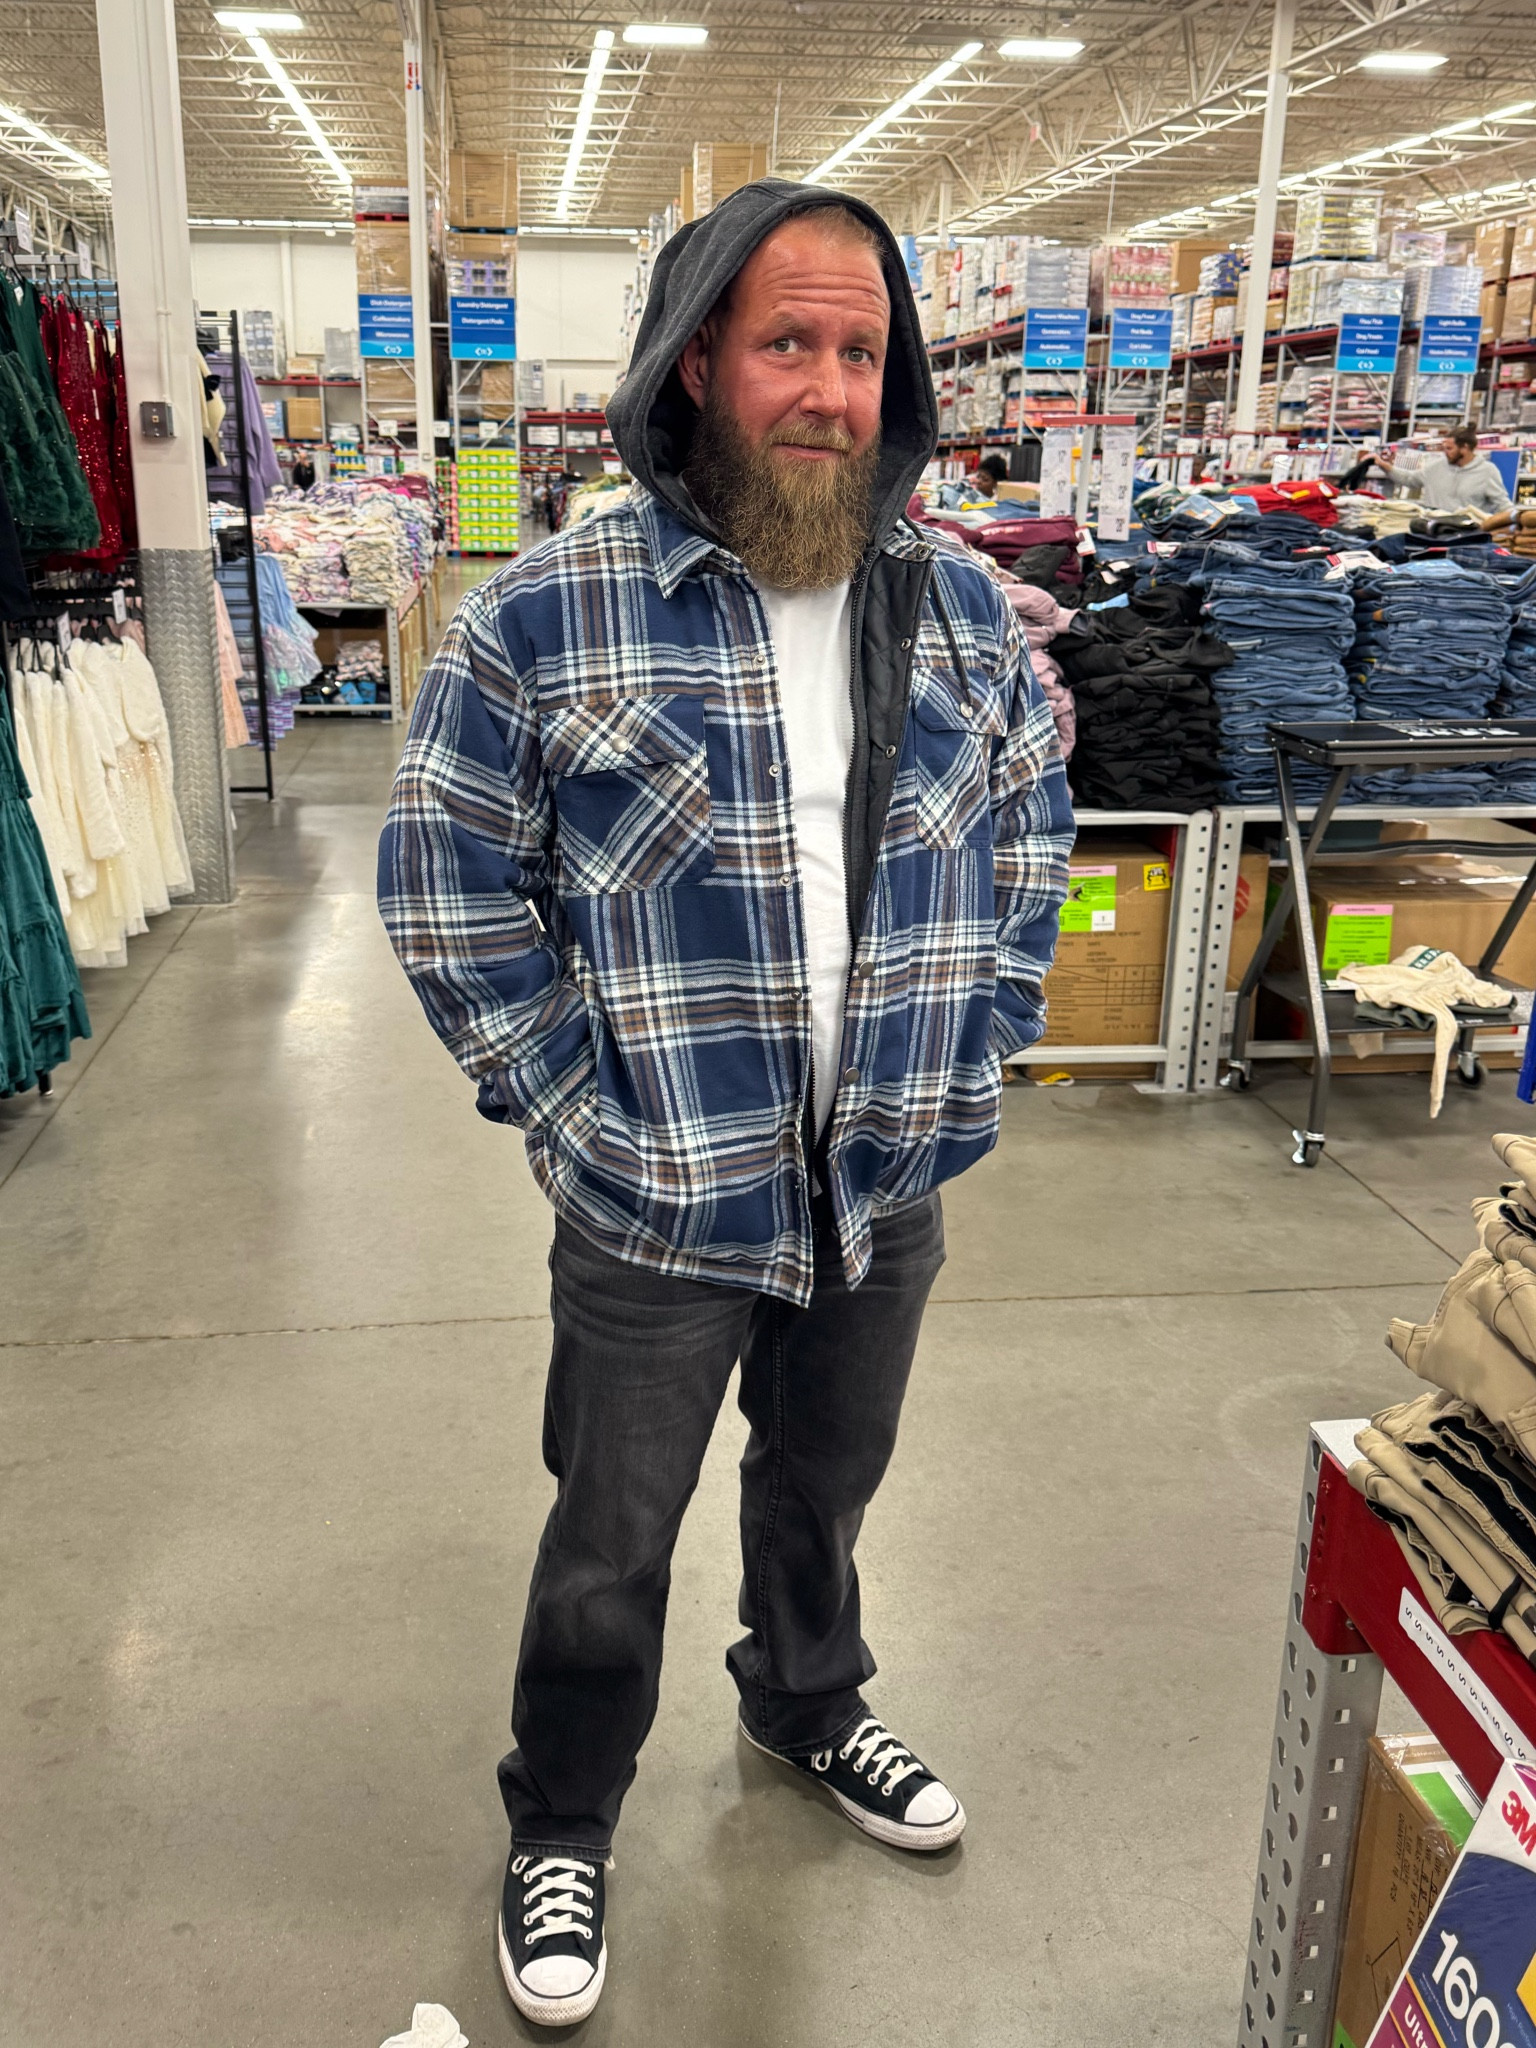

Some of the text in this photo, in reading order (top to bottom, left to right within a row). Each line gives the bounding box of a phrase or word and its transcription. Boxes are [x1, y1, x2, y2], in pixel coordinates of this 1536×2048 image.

[1395, 1812, 1405, 1857] QUANTITY
[1501, 1790, 1536, 1857] 3M
[1432, 1930, 1516, 2048] 160
